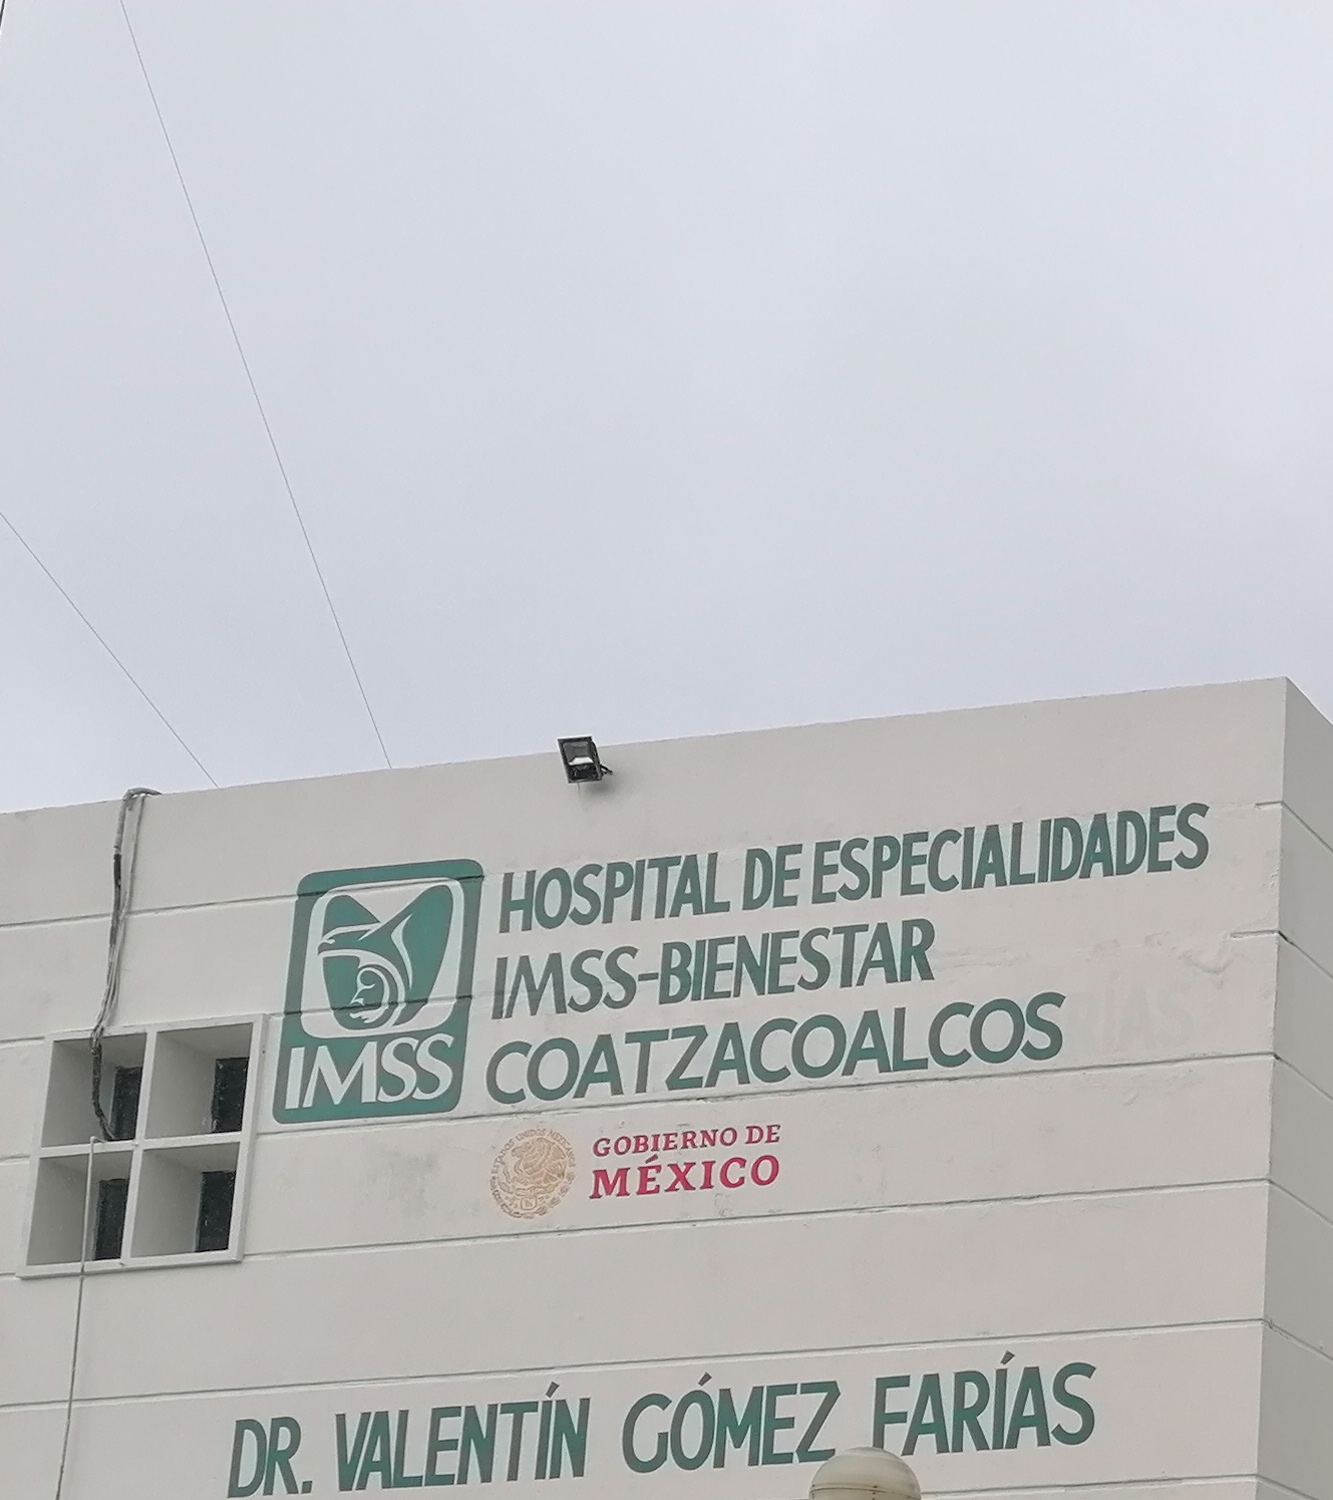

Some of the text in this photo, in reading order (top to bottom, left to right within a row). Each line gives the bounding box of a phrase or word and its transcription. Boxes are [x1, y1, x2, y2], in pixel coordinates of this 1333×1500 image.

[499, 802, 1210, 934] HOSPITAL DE ESPECIALIDADES
[492, 918, 935, 1020] IMSS-BIENESTAR
[285, 1035, 455, 1112] IMSS
[485, 991, 1066, 1105] COATZACOALCOS
[589, 1154, 780, 1200] MÉXICO
[592, 1124, 781, 1158] GOBIERNO DE
[227, 1351, 1097, 1499] DR. VALENTÍN GÓMEZ FARÍAS
